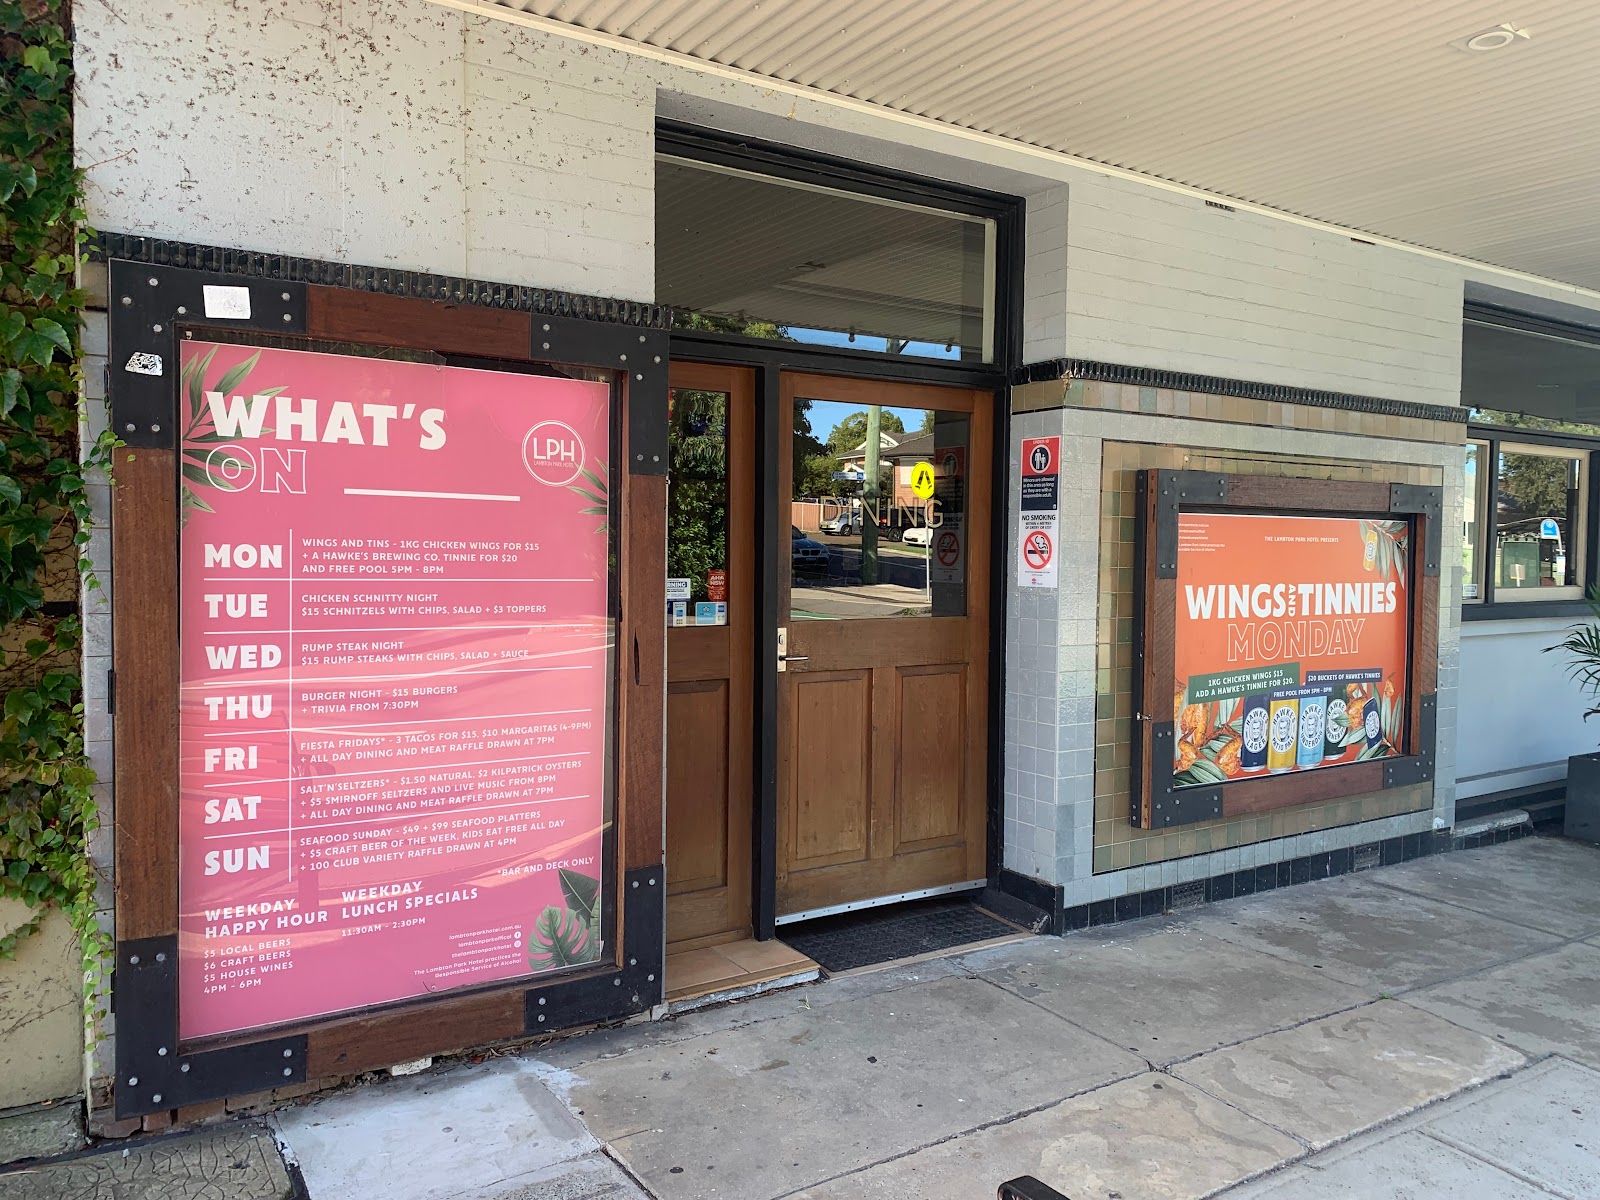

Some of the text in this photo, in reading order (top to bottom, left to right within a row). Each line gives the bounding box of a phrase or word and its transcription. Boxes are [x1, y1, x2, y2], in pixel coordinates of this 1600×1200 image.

[205, 390, 447, 451] WHAT'S
[533, 437, 574, 461] LPH
[205, 445, 307, 495] ON
[821, 495, 944, 529] DINING
[204, 543, 283, 569] MON
[302, 539, 338, 547] WINGS
[341, 539, 364, 548] AND
[367, 540, 390, 548] TINS
[400, 540, 420, 549] 1KG
[423, 541, 466, 549] CHICKEN
[469, 542, 500, 550] WINGS
[524, 542, 540, 551] $15
[312, 552, 517, 563] A HAWKE'S BREWING CO. TINNIE FOR $20
[204, 593, 268, 619] TUE
[301, 594, 438, 603] CHICKEN SCHNITTY NIGHT
[302, 607, 319, 616] $15
[323, 607, 386, 615] SCHNITZELS
[418, 606, 450, 615] CHIPS,
[453, 606, 482, 614] SALAD
[493, 605, 503, 614] $3
[506, 605, 547, 613] TOPPERS
[1185, 581, 1396, 620] WINGS AND TINNIES
[302, 641, 404, 652] RUMP STEAK NIGHT
[1227, 618, 1366, 662] MONDAY
[205, 644, 282, 670] WED
[1195, 690, 1209, 698] ADD
[1211, 688, 1216, 696] A
[1218, 684, 1245, 695] HAWKE'S
[1246, 681, 1267, 690] TINNIE
[1269, 679, 1281, 687] FOR
[1208, 679, 1221, 687] 1KG
[1222, 674, 1250, 685] CHICKEN
[1252, 671, 1271, 680] WINGS
[1317, 673, 1337, 681] BUCKETS
[302, 686, 458, 701] BURGER NIGHT $15 BURGERS
[204, 695, 272, 720] THU
[311, 700, 419, 714] TRIVIA FROM 7:30PM
[300, 741, 335, 750] FIESTA
[396, 736, 401, 744] 3
[405, 733, 436, 743] TACOS
[439, 732, 458, 740] FOR
[482, 729, 498, 738] $10
[501, 724, 557, 736] MARGARITAS
[1246, 735, 1266, 751] LAGER
[204, 746, 257, 772] FRI
[310, 754, 328, 763] ALL
[332, 752, 352, 761] DAY
[356, 749, 393, 759] DINING
[397, 747, 418, 756] AND
[421, 745, 446, 754] MEAT
[450, 742, 484, 752] RAFFLE
[487, 739, 521, 748] DRAWN
[537, 736, 555, 744] 7PM
[400, 775, 425, 786] $1.50
[478, 769, 488, 778] $2
[491, 764, 543, 776] KILPATRICK
[545, 760, 582, 771] OYSTERS
[204, 796, 261, 824] SAT
[300, 811, 541, 846] SEAFOOD SUNDAY $49 $99 SEAFOOD PLATTERS
[204, 845, 269, 876] SUN
[523, 864, 543, 874] AND
[546, 859, 569, 870] DECK
[571, 856, 595, 866] ONLY
[341, 881, 423, 902] WEEKDAY
[342, 888, 478, 919] LUNCH SPECIALS
[204, 898, 295, 922] WEEKDAY
[205, 910, 328, 939] HAPPY HOUR
[341, 917, 426, 937] 11:30AM 2:30PM
[204, 938, 291, 959] $5 LOCAL BEERS
[203, 978, 262, 994] 4PM 6PM
